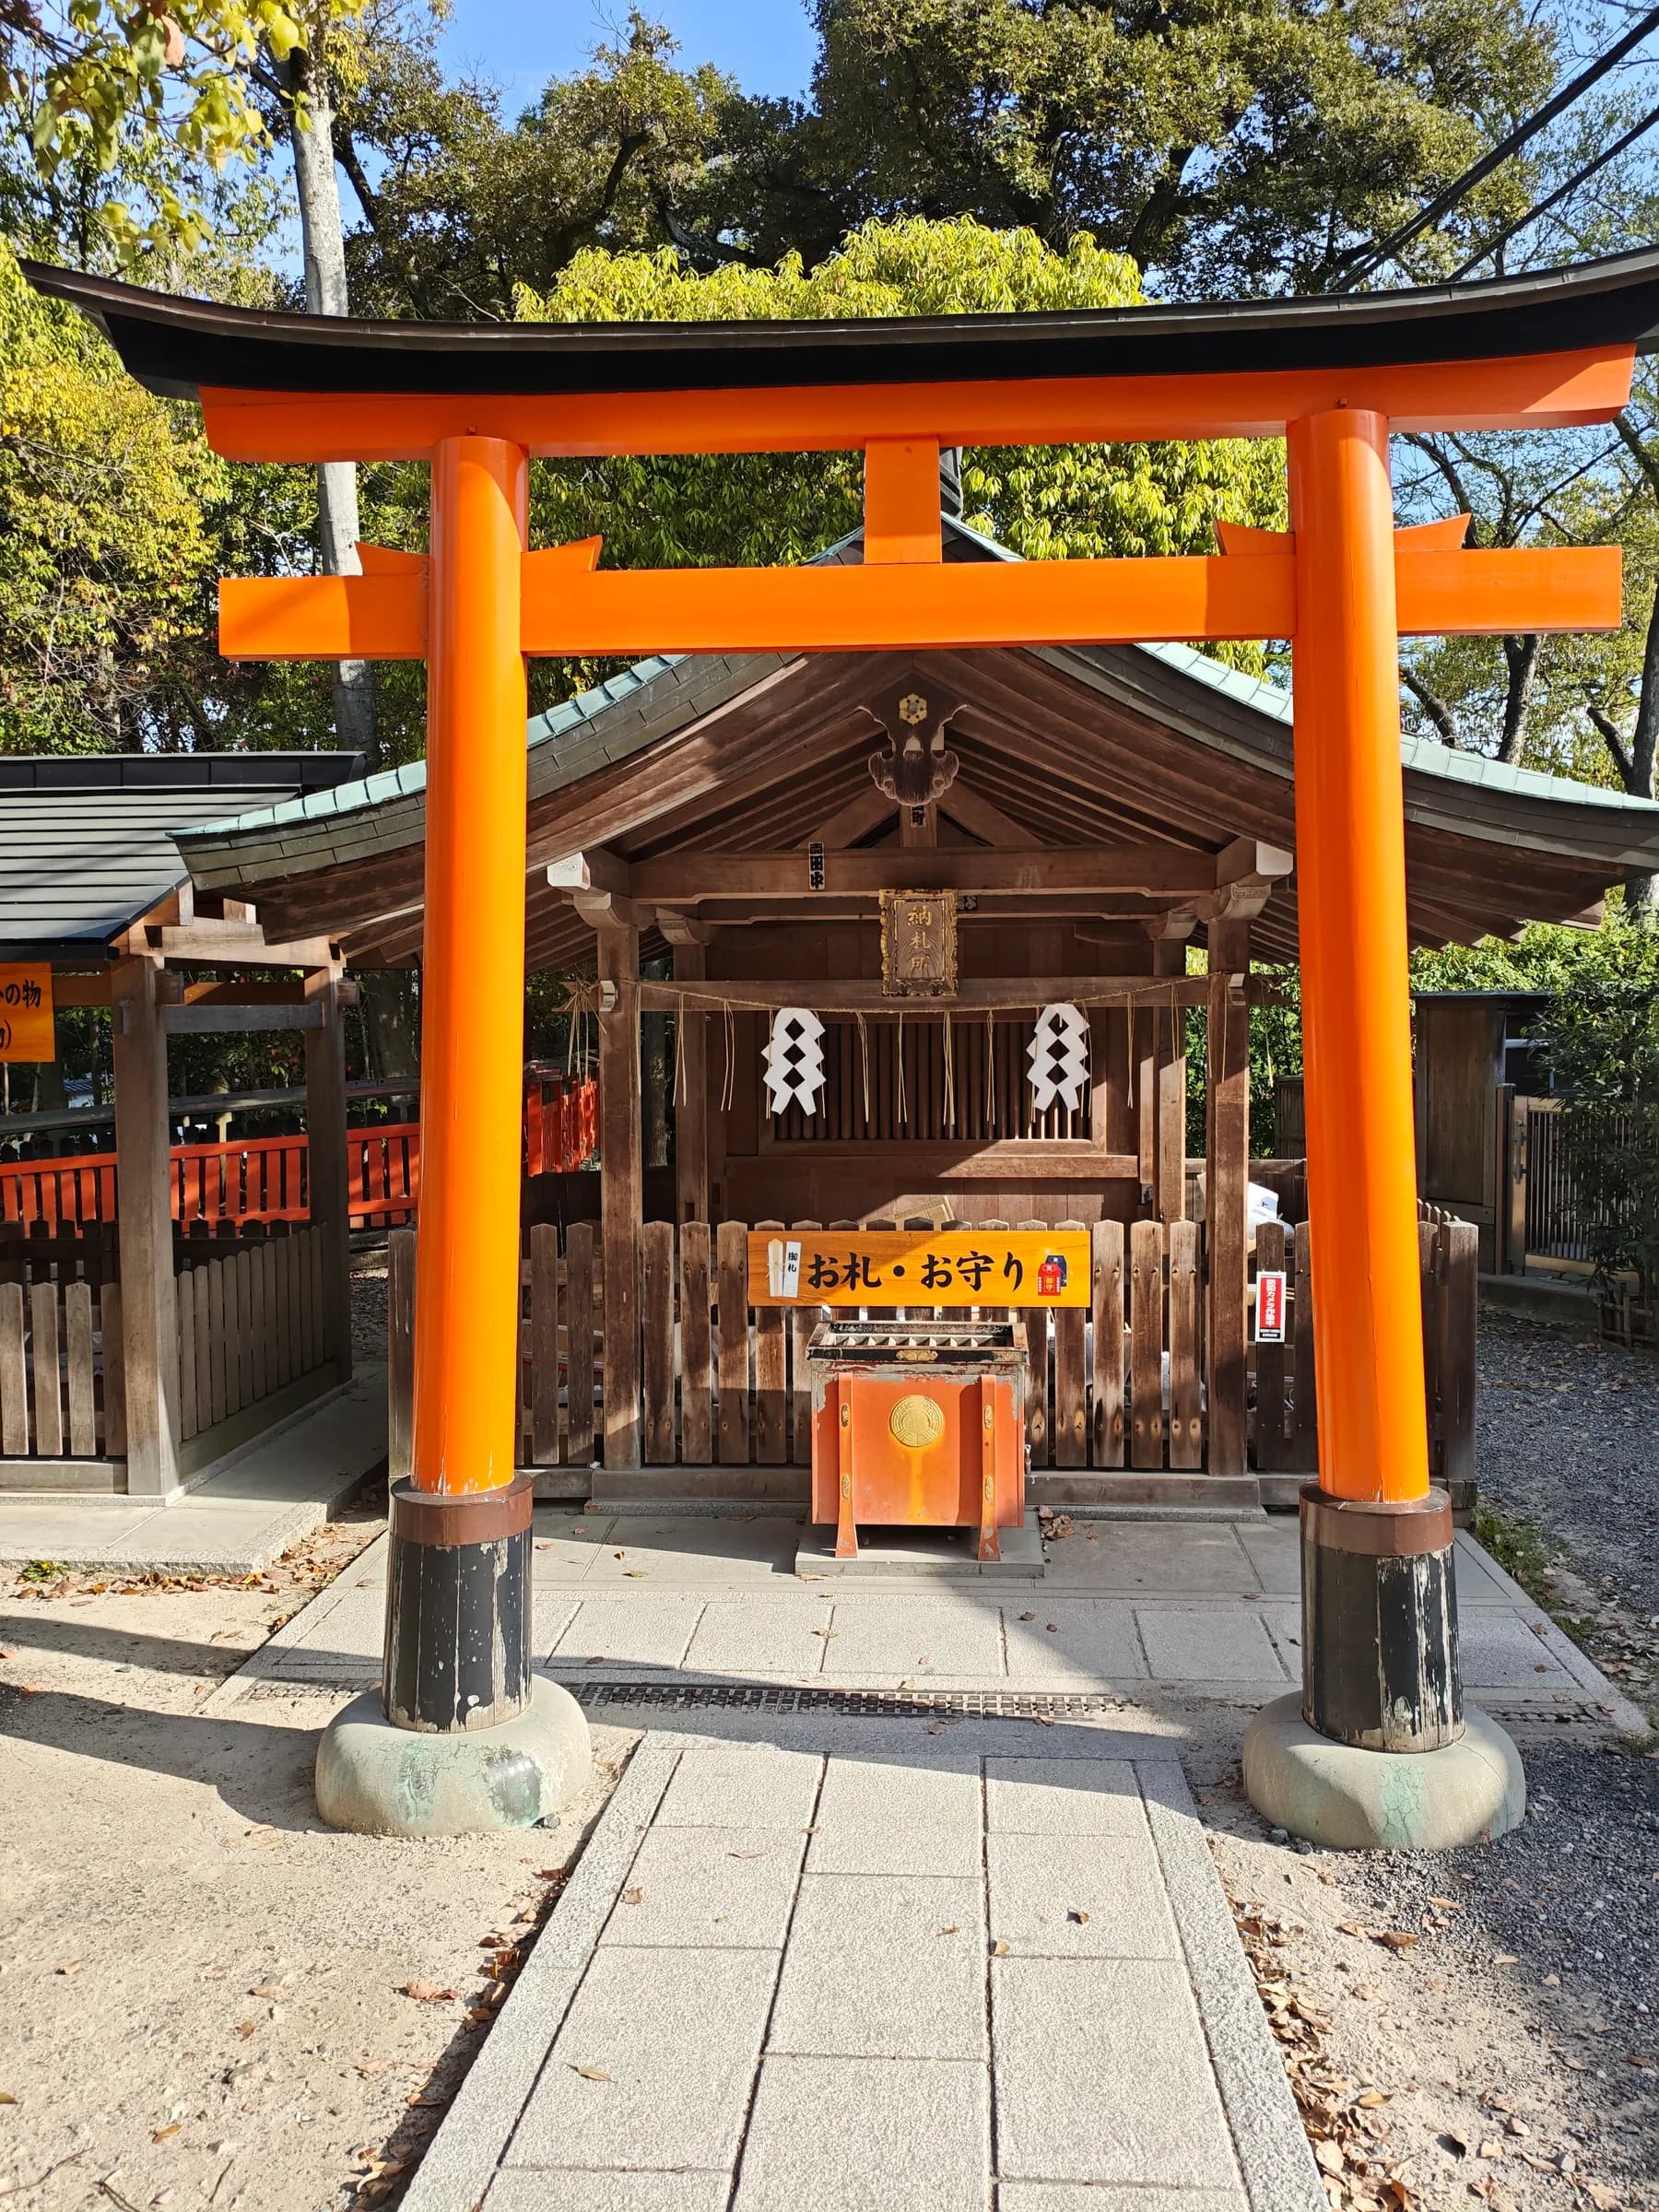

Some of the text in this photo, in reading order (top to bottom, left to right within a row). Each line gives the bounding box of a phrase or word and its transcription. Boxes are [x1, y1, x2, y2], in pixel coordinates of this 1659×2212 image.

[907, 905, 932, 971] 納札所
[0, 979, 41, 1009] の物
[788, 1252, 798, 1273] 御札
[807, 1251, 1023, 1291] お札・お守り
